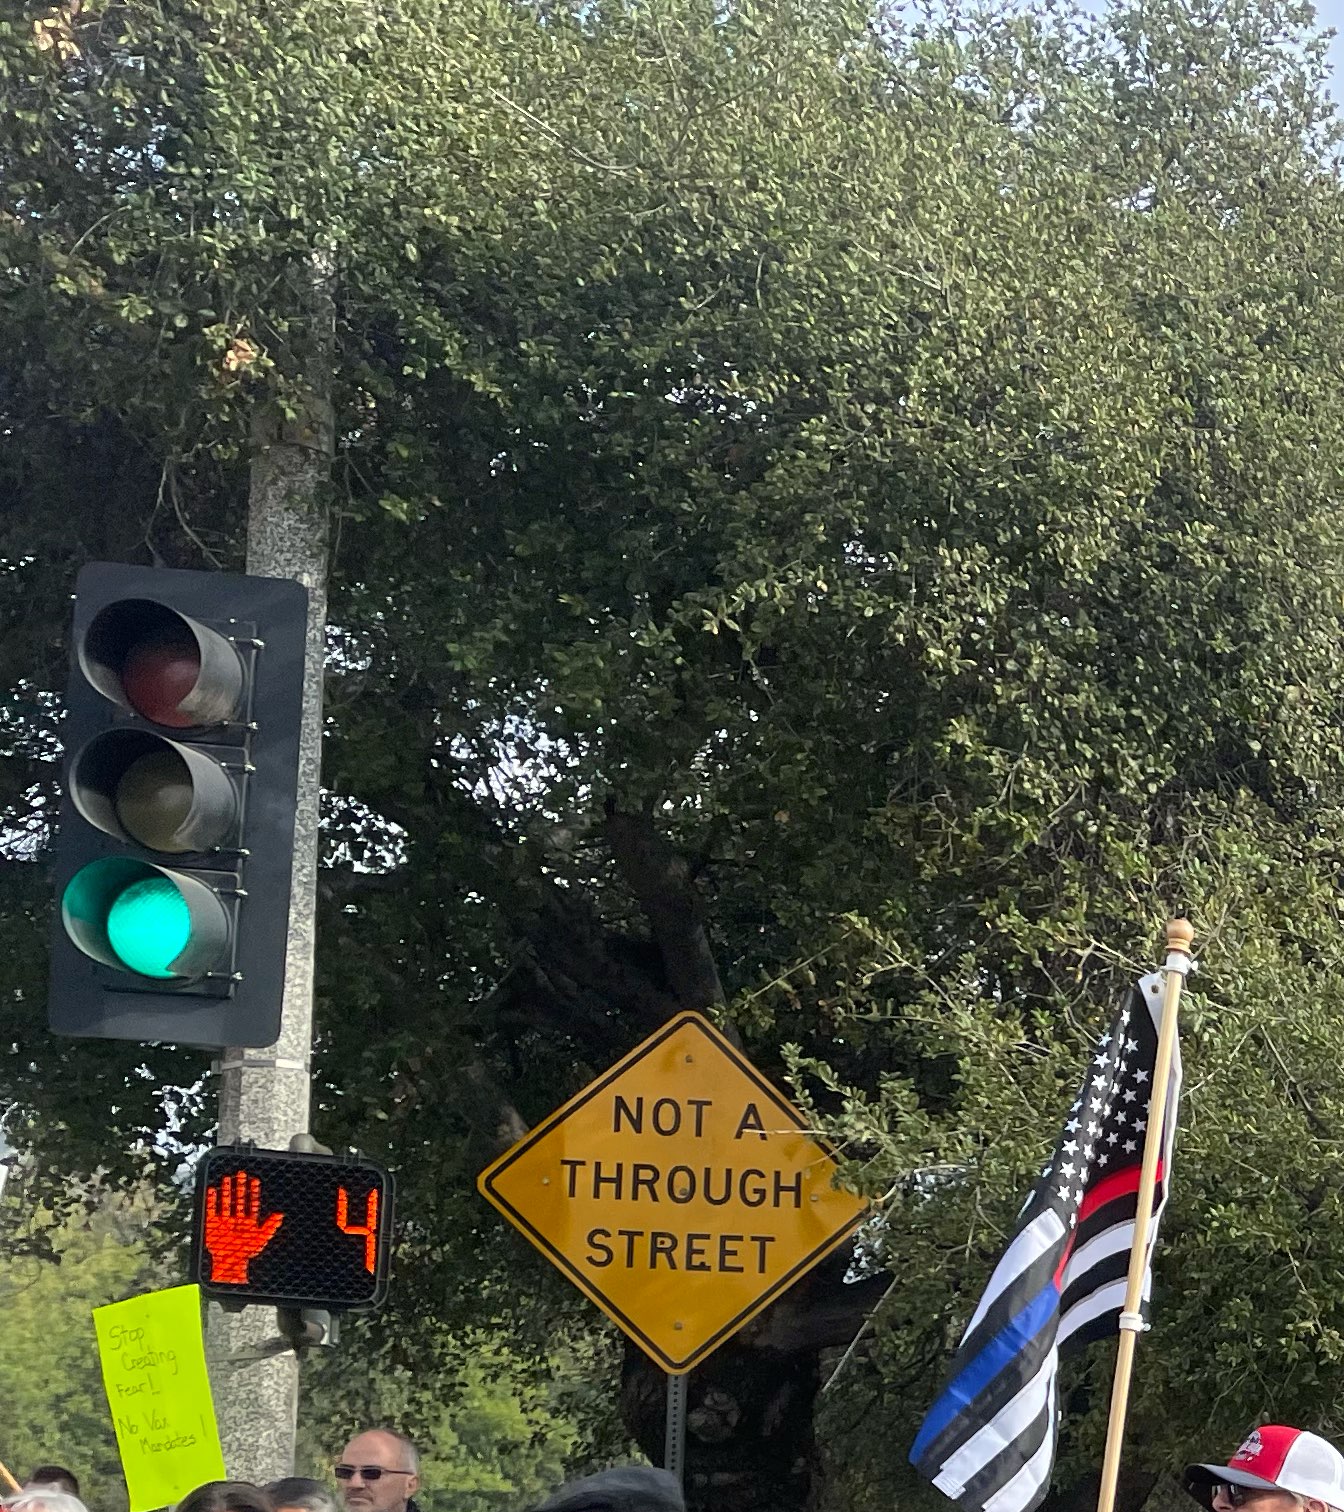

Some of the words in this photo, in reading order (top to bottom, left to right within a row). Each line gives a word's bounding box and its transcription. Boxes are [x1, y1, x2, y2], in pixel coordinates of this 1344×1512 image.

[613, 1096, 712, 1138] NOT
[734, 1103, 768, 1141] A
[560, 1159, 802, 1208] THROUGH
[337, 1185, 378, 1275] 4
[586, 1228, 775, 1274] STREET
[109, 1325, 145, 1351] Stop
[121, 1346, 179, 1376] Creating
[118, 1414, 139, 1439] No
